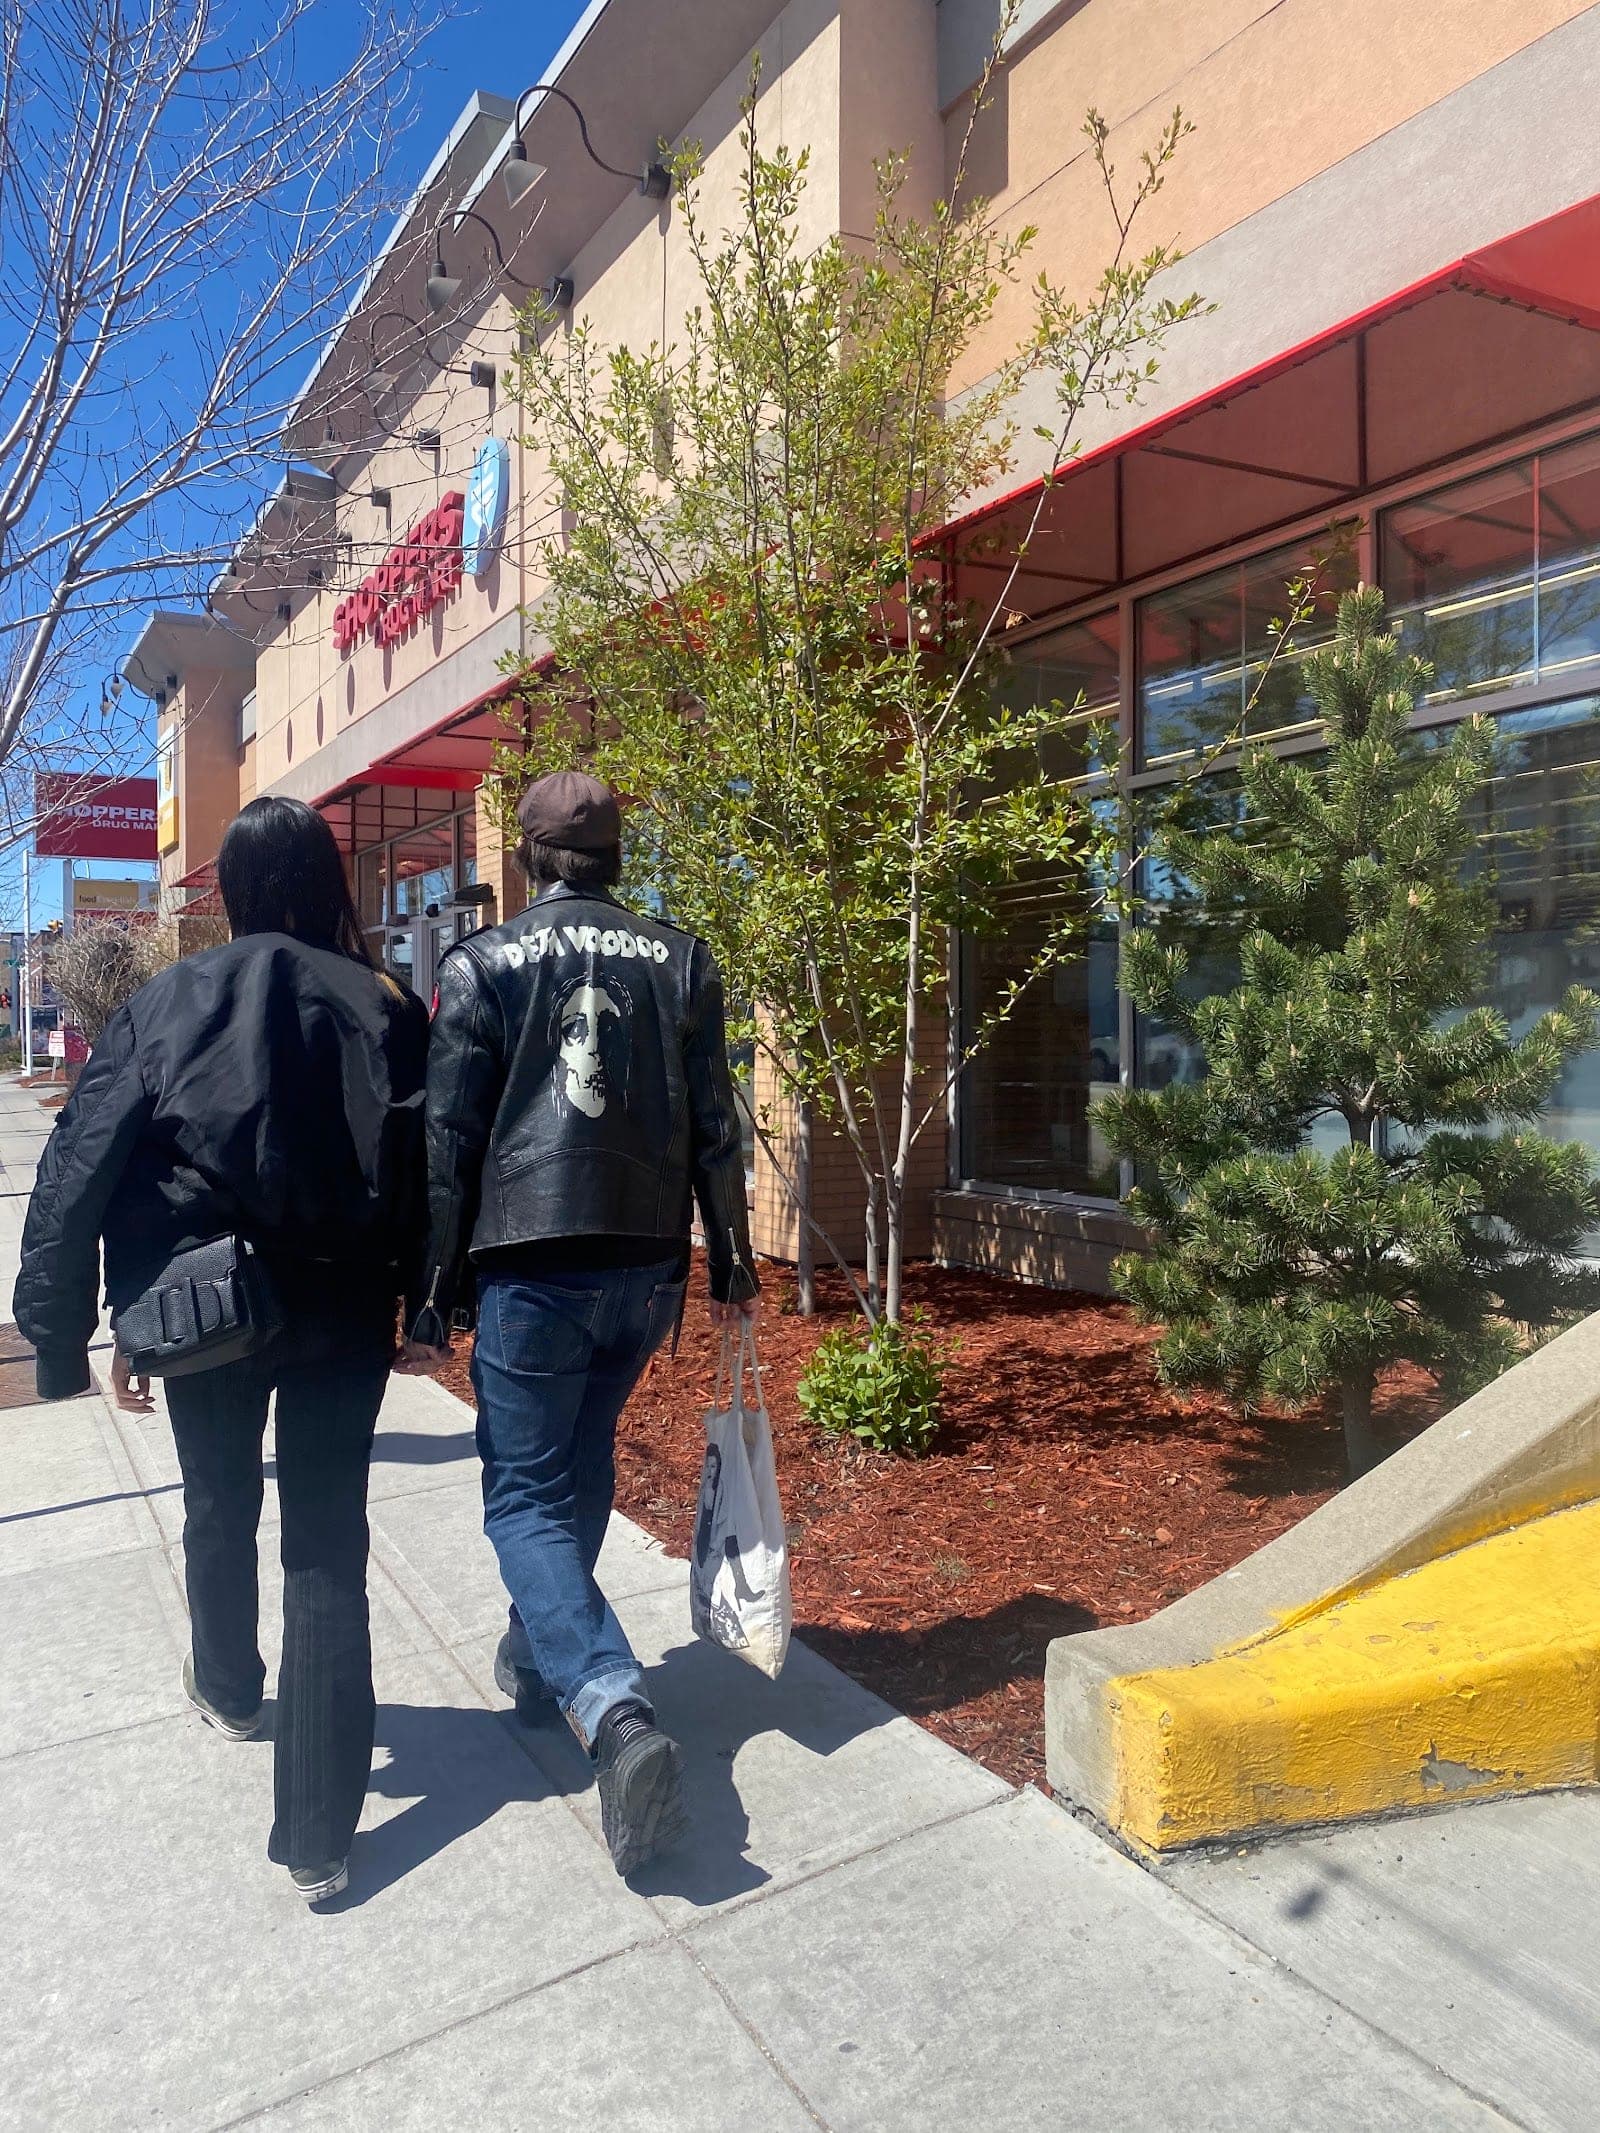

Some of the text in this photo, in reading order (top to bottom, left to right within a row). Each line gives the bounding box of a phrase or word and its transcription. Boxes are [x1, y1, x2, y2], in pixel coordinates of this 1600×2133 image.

[333, 490, 465, 650] SHOPPERS
[42, 802, 157, 821] HOPPER
[92, 820, 130, 829] DRUG
[502, 925, 669, 969] DEJA VOODOO
